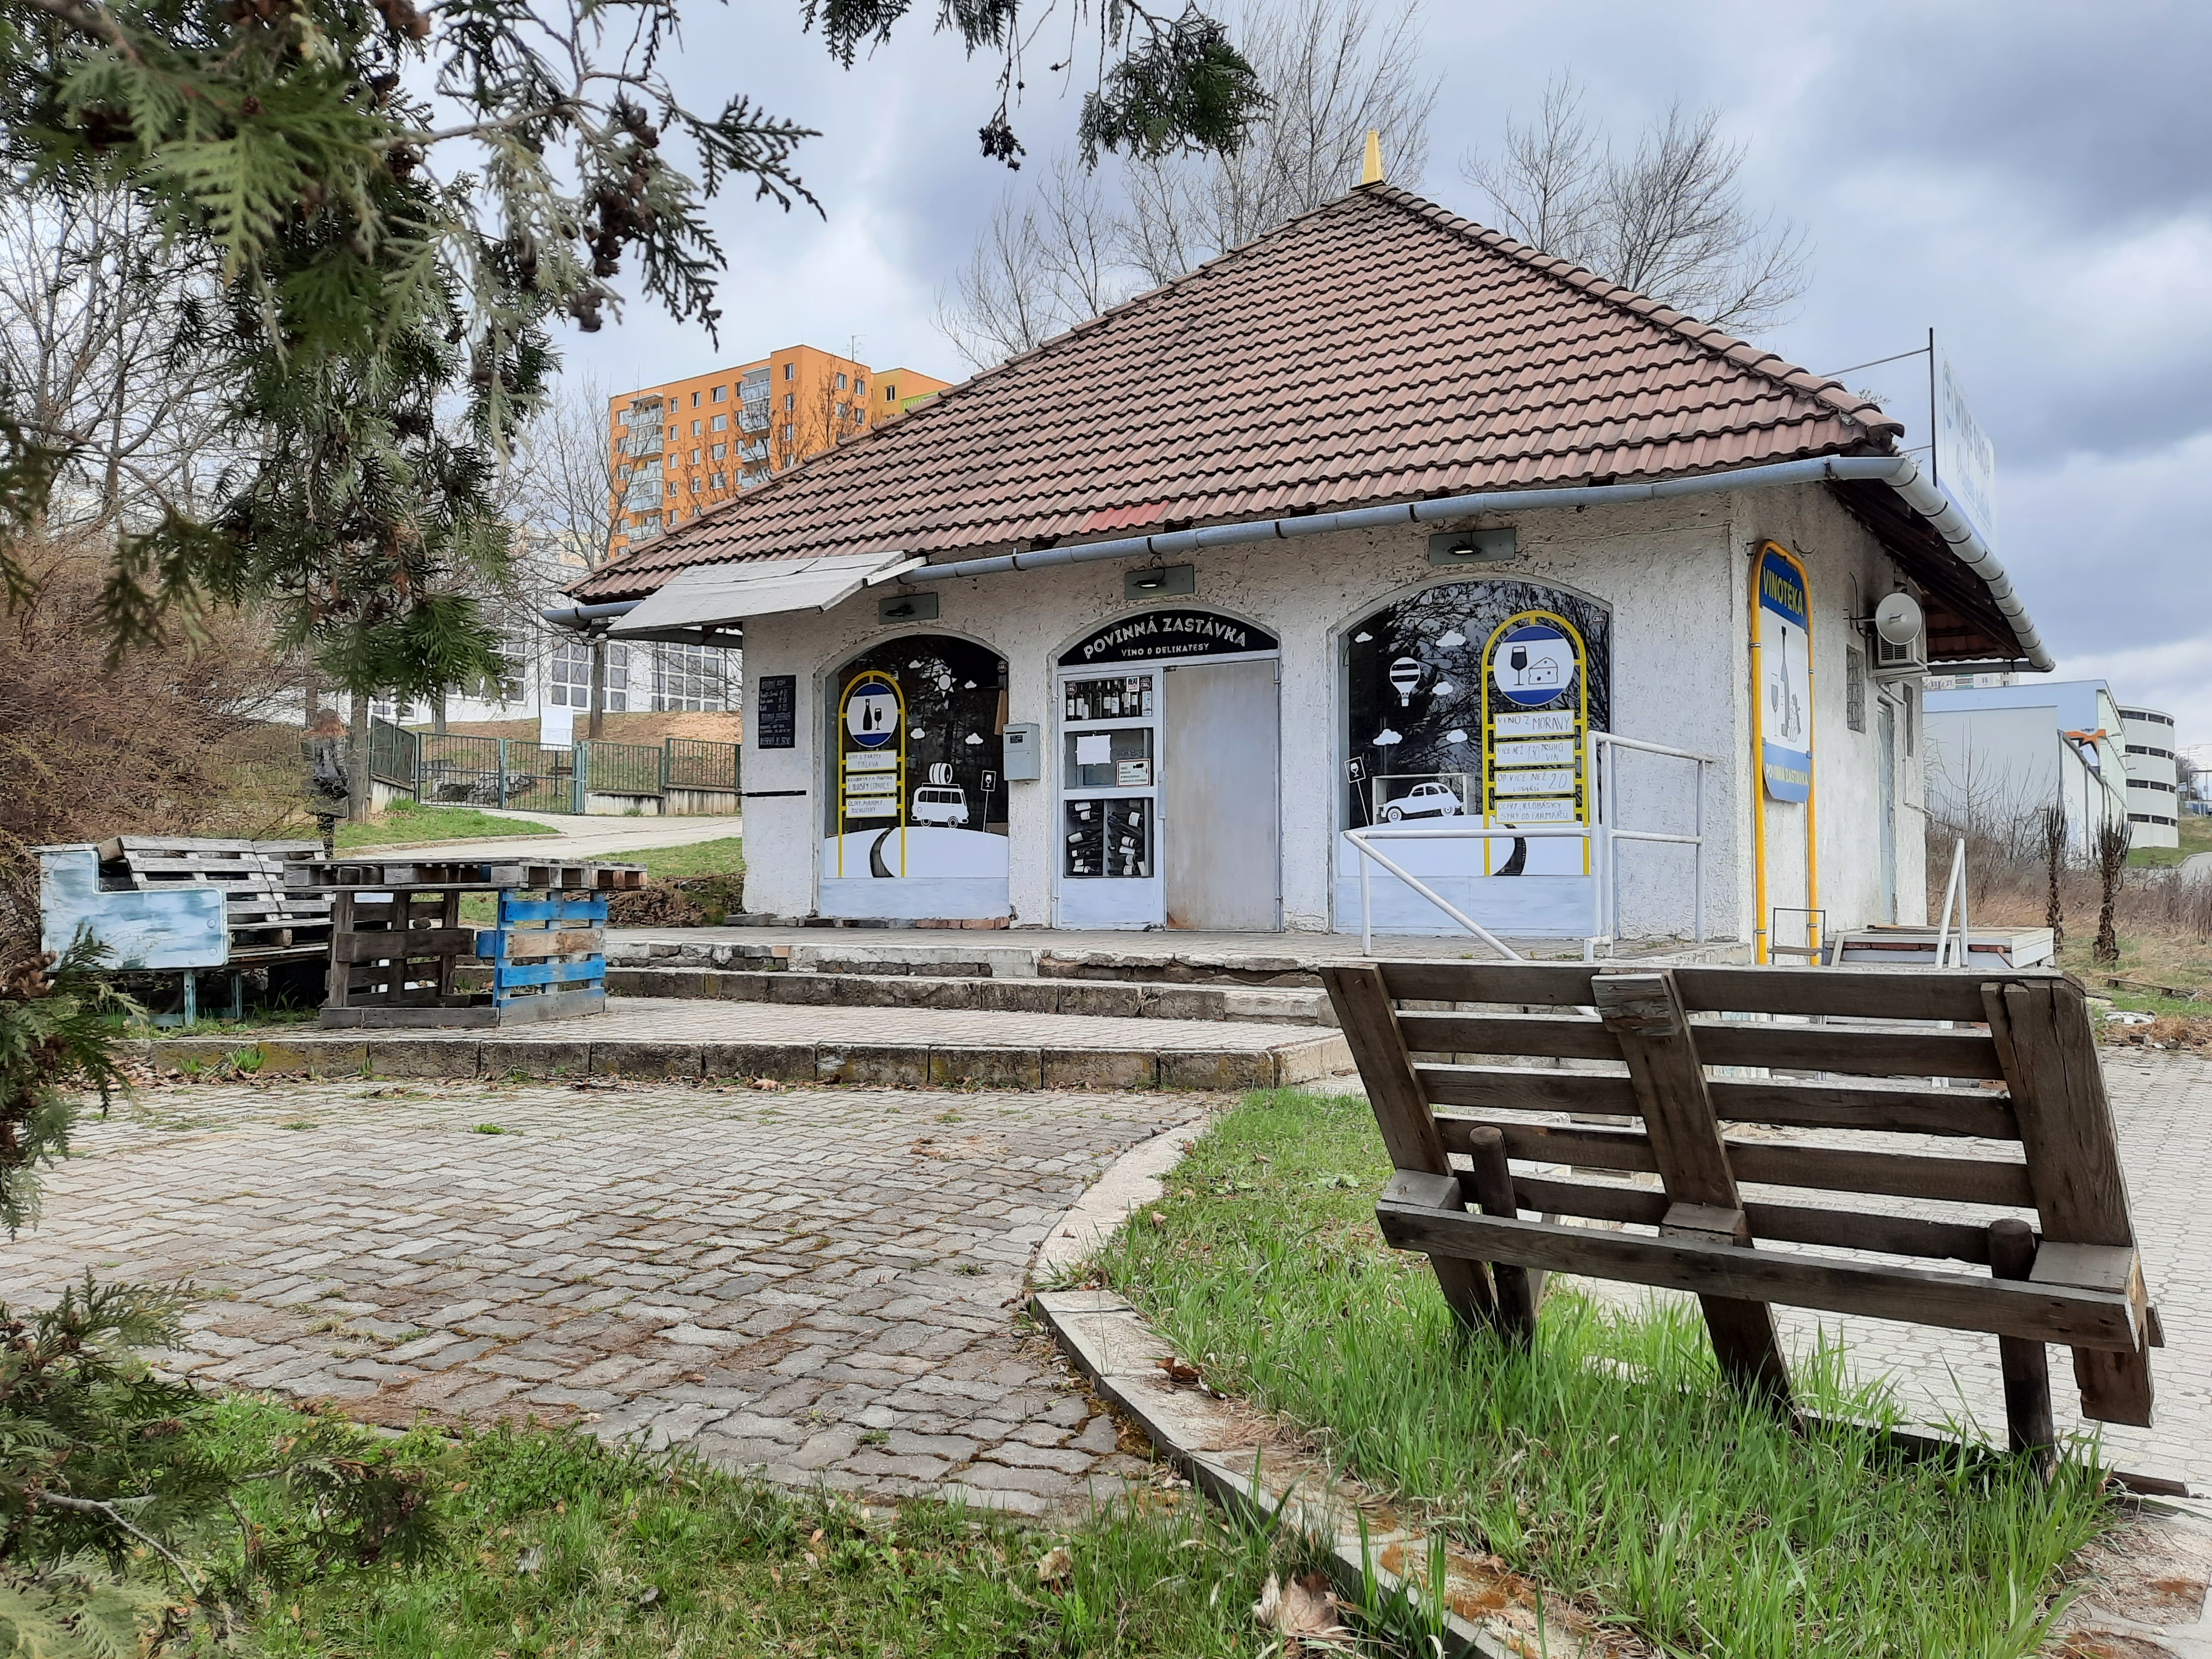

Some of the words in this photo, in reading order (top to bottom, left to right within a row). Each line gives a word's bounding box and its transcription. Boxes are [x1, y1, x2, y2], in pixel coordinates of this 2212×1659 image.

[1763, 566, 1803, 617] VINOTÉKA
[1083, 615, 1157, 659] POVINNÁ
[1162, 617, 1245, 647] ZASTÁVKA
[1121, 646, 1144, 656] VÍNO
[1155, 643, 1209, 654] DELIKATESY
[1523, 716, 1530, 725] Z
[1532, 716, 1570, 731] MORAVY
[1526, 745, 1540, 761] 130
[1548, 773, 1568, 789] 20
